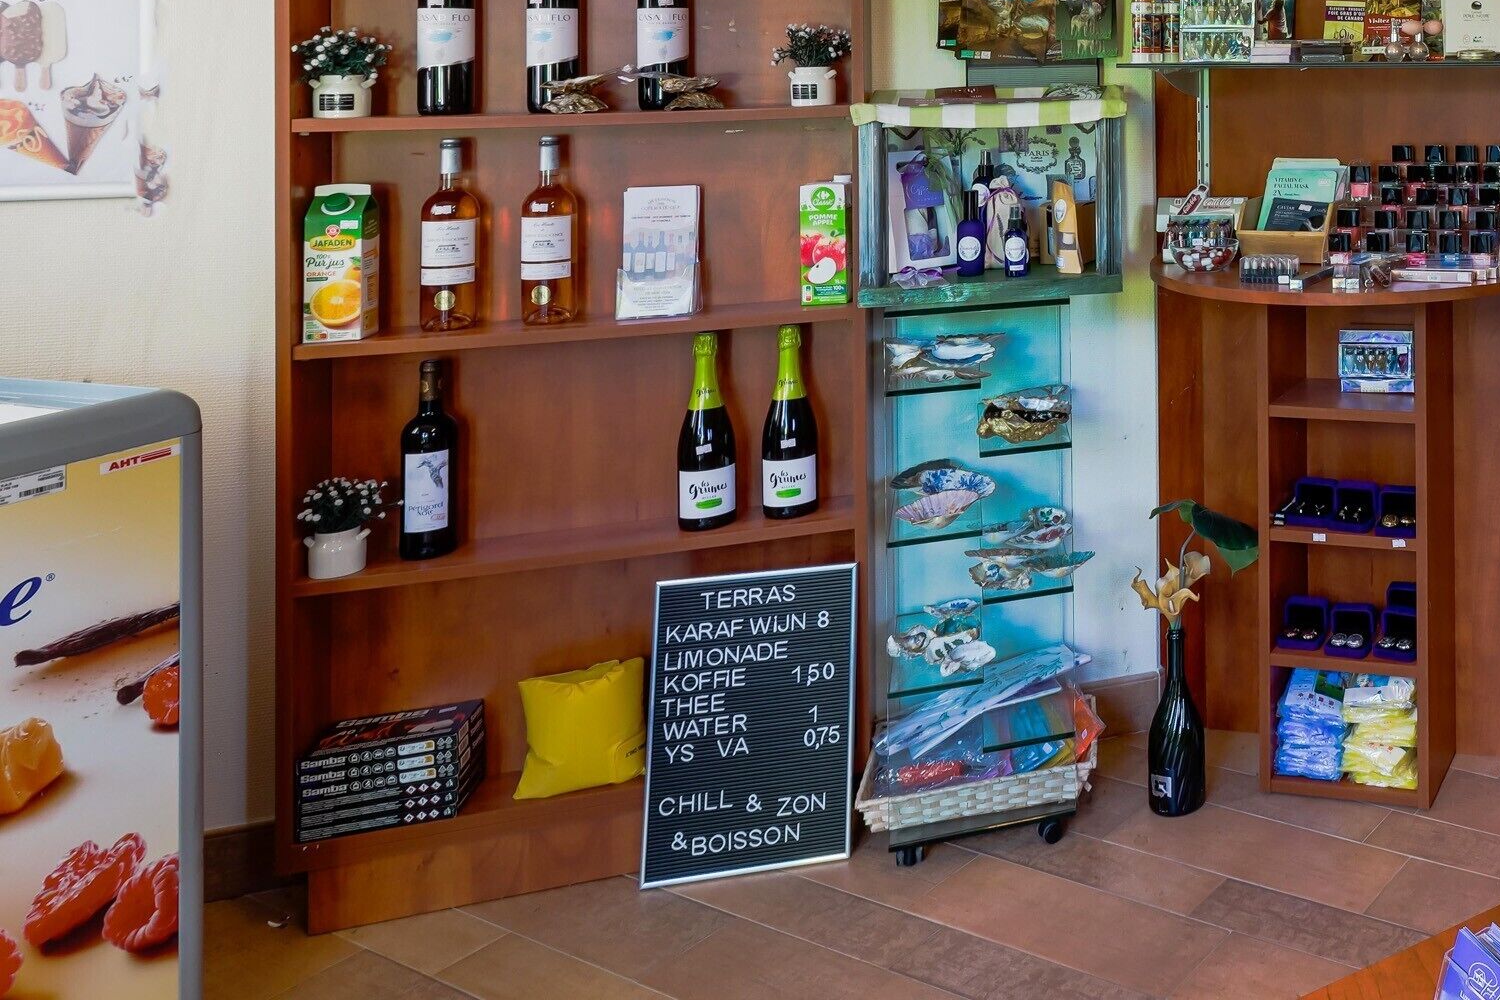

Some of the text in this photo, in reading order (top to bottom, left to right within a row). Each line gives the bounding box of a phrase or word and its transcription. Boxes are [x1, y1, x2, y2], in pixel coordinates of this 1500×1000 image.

[313, 239, 352, 248] JAFADEN
[306, 256, 345, 270] Pur jus
[109, 455, 141, 472] AHT
[700, 584, 797, 610] TERRAS
[665, 618, 744, 644] KARAF
[817, 610, 830, 628] 8
[664, 662, 835, 694] KOFFIE 1,50
[660, 693, 726, 717] THEE
[663, 705, 819, 741] WATER 1
[665, 725, 841, 764] YS VA 0,75
[301, 756, 348, 770] Samba
[301, 770, 347, 784] Samba
[302, 783, 349, 798] Samba
[658, 790, 827, 817] CHILL & ZON
